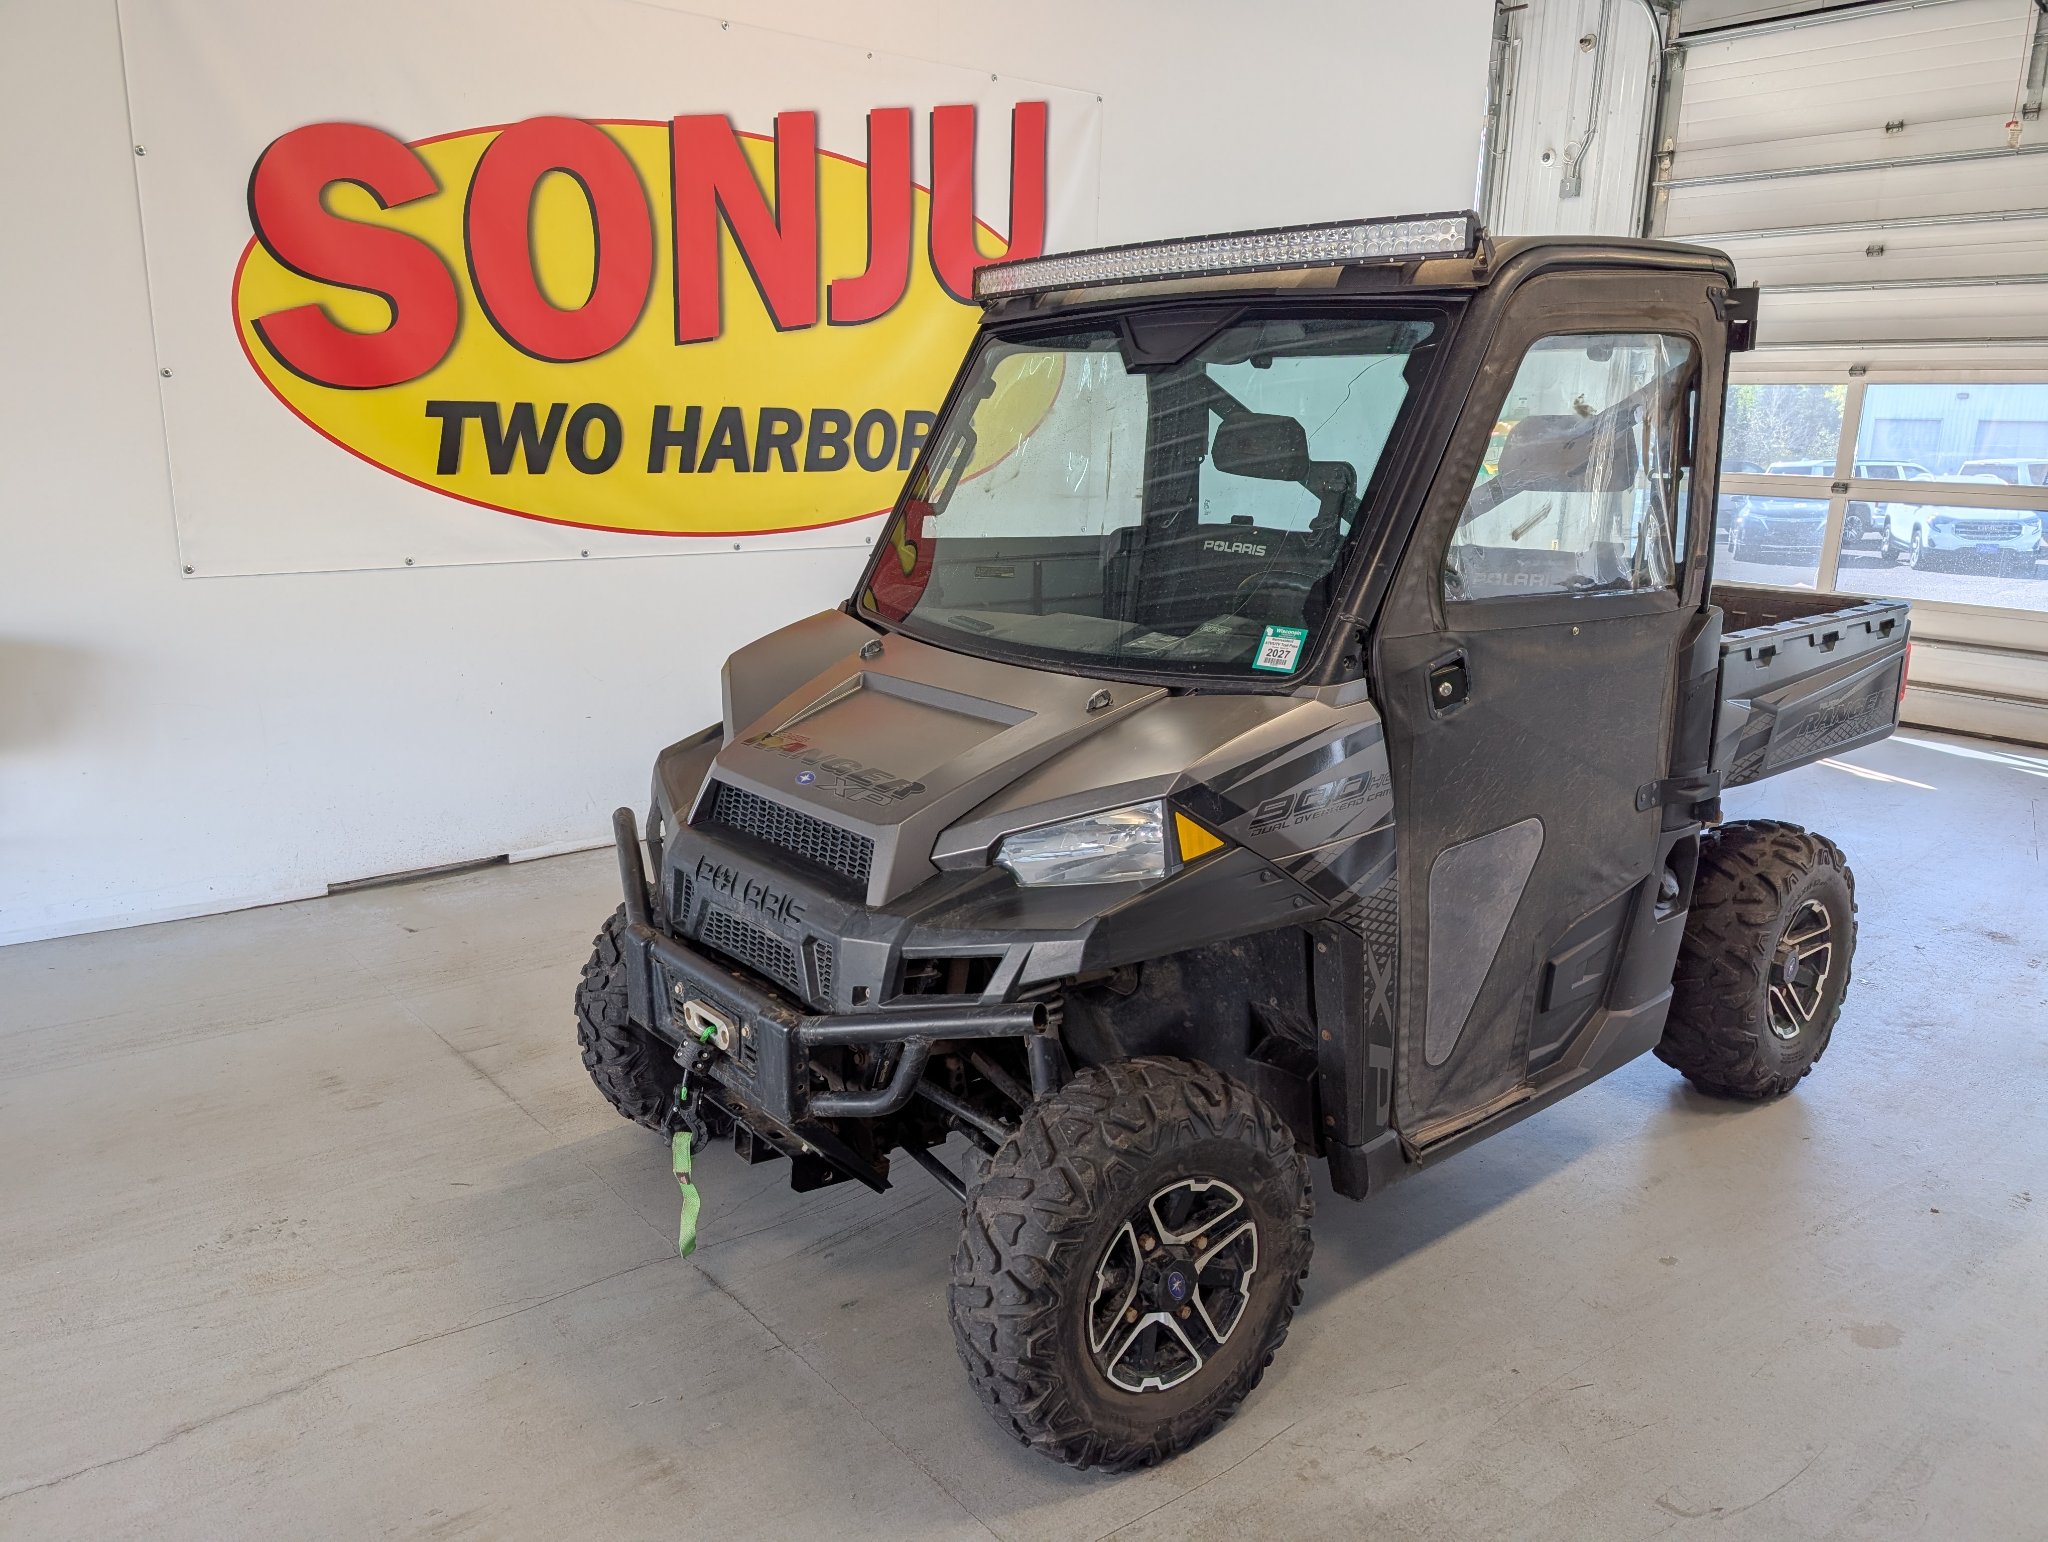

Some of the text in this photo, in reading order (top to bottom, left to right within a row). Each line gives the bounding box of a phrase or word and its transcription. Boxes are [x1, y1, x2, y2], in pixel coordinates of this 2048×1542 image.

[248, 101, 1048, 390] SONJU
[424, 400, 940, 476] TWO HARBOR
[1203, 540, 1267, 557] POLARIS
[1472, 572, 1552, 588] POLARI
[1265, 648, 1291, 659] 2027
[1248, 769, 1373, 830] 900
[1250, 788, 1392, 837] DUAL OVERHEAD CAM
[695, 854, 807, 928] POLARIS
